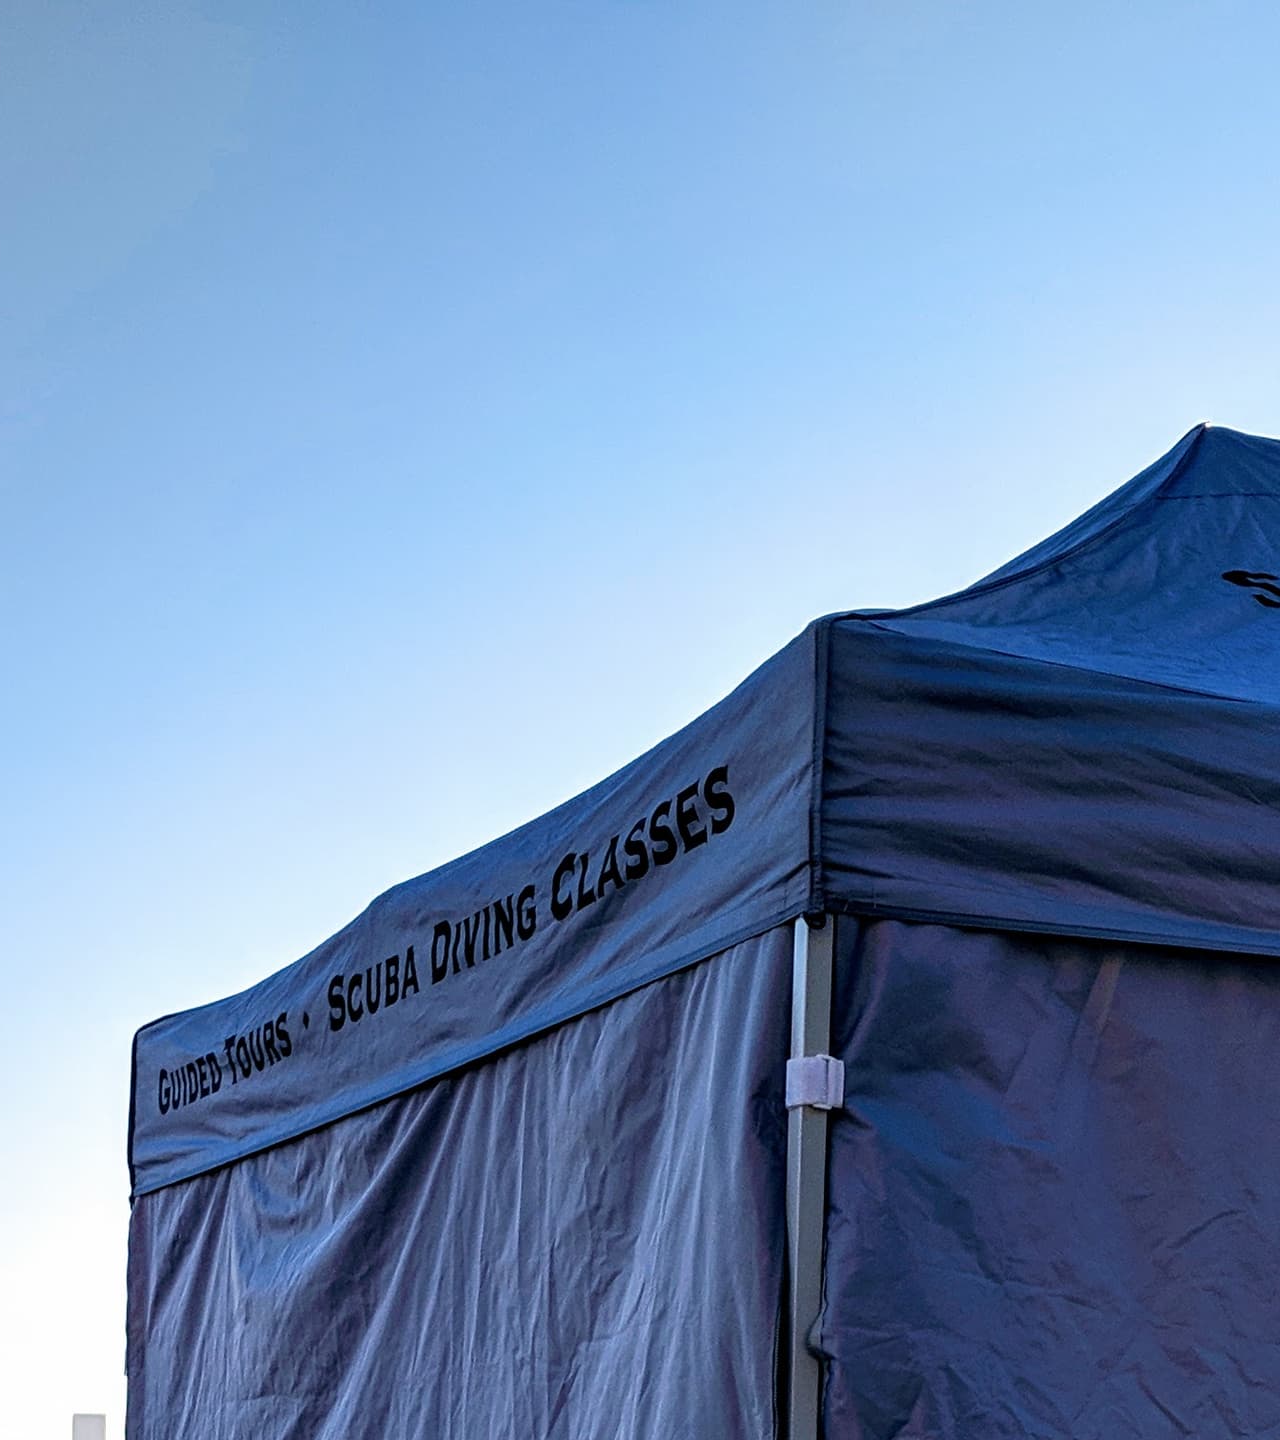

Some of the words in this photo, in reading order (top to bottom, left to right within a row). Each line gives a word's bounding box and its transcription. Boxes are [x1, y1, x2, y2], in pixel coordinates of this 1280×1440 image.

[158, 1052, 223, 1115] GUIDED
[223, 1012, 292, 1085] TOURS
[327, 946, 420, 1033] SCUBA
[431, 883, 537, 986] DIVING
[549, 764, 735, 922] CLASSES
